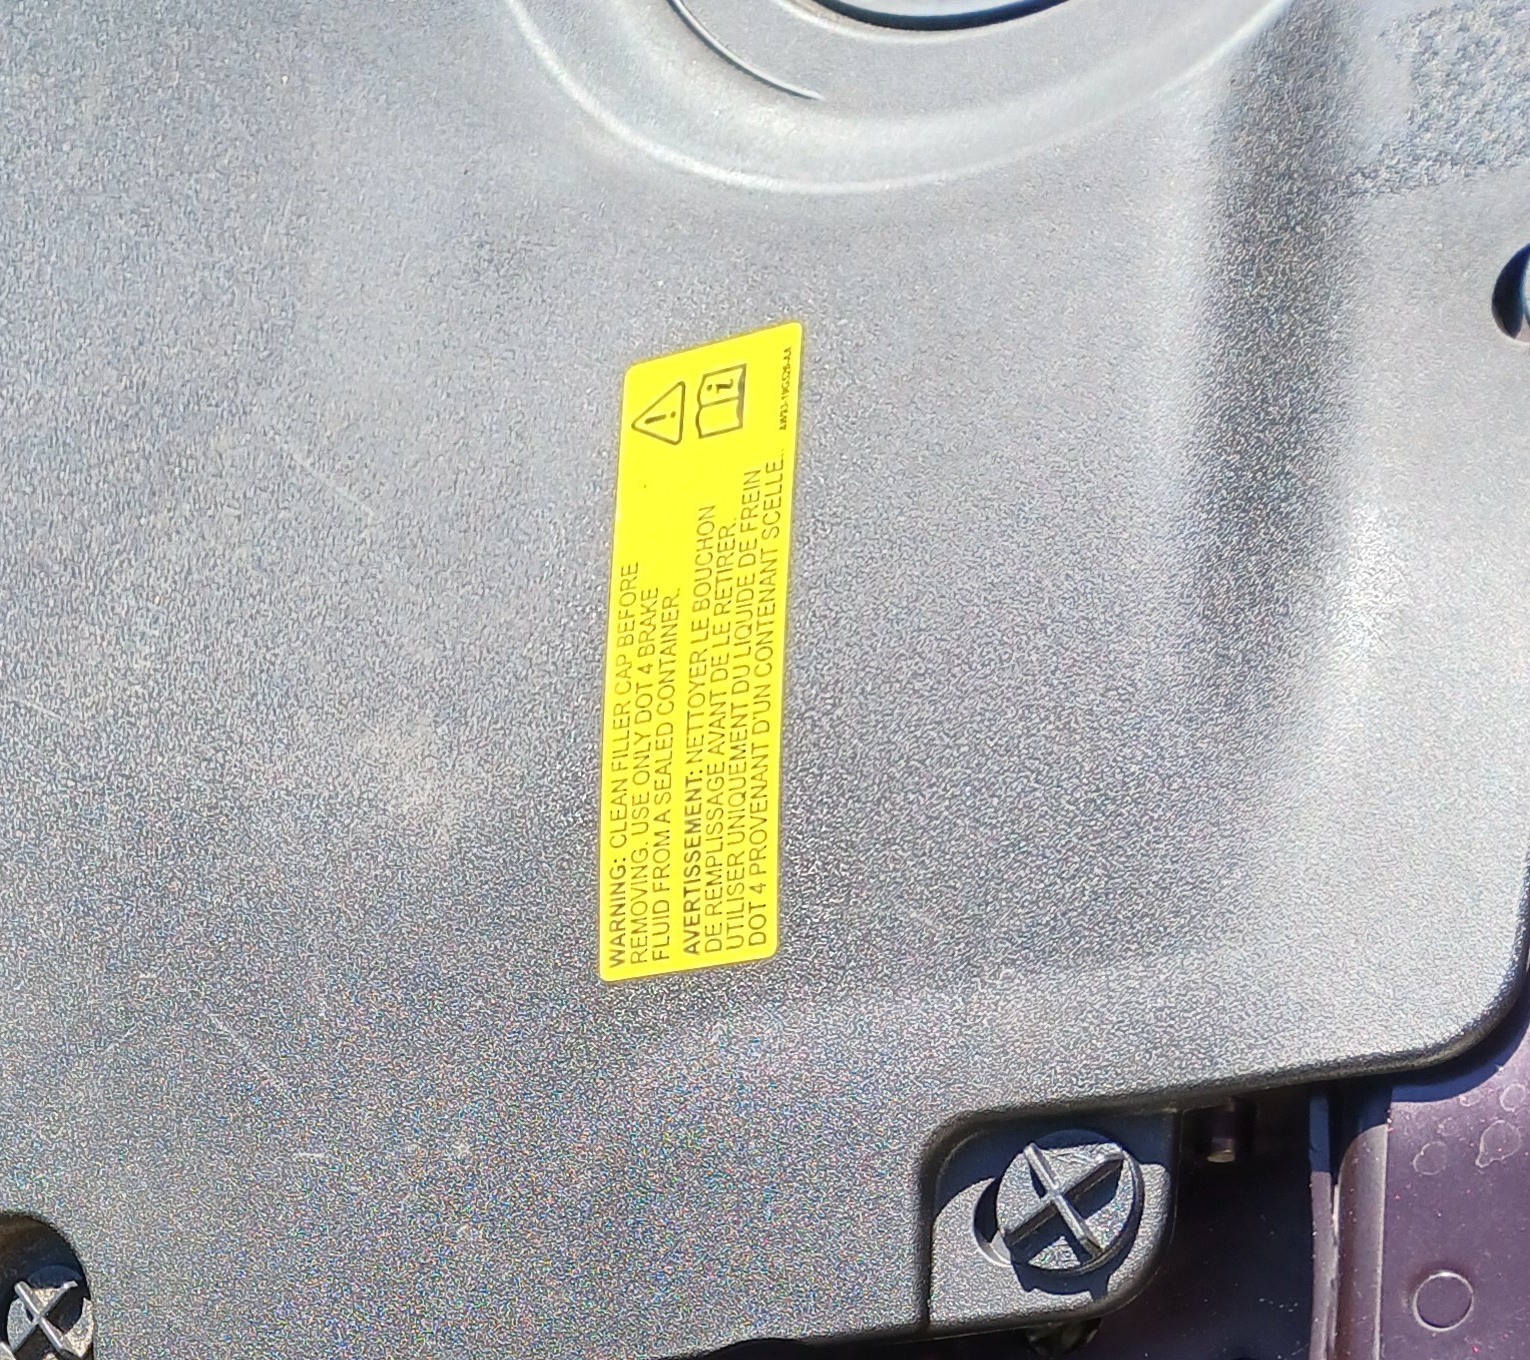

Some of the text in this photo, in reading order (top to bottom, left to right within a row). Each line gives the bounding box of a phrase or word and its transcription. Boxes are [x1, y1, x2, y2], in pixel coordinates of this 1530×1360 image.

[608, 561, 638, 967] WARNING: CLEAN FILLER CAP BEFORE
[630, 587, 658, 964] REMOVING. USE ONLY DOT 4 BRAKE
[651, 587, 680, 961] FLUID FROM A SEALED CONTAINER.
[682, 505, 715, 955] AVERTISSEMENT: NETTOYER LE BOUCHON
[704, 517, 736, 953] DE REMPLISSAGE AVANT DE LE RETIRER.
[725, 469, 761, 950] UTILISER UNIQUEMENT DU LIQUIDE DE FREIN
[751, 683, 771, 735] D'UN
[754, 548, 777, 677] CONTENANT
[748, 742, 768, 875] PROVENANT
[748, 901, 766, 946] DOT
[749, 882, 766, 894] 4
